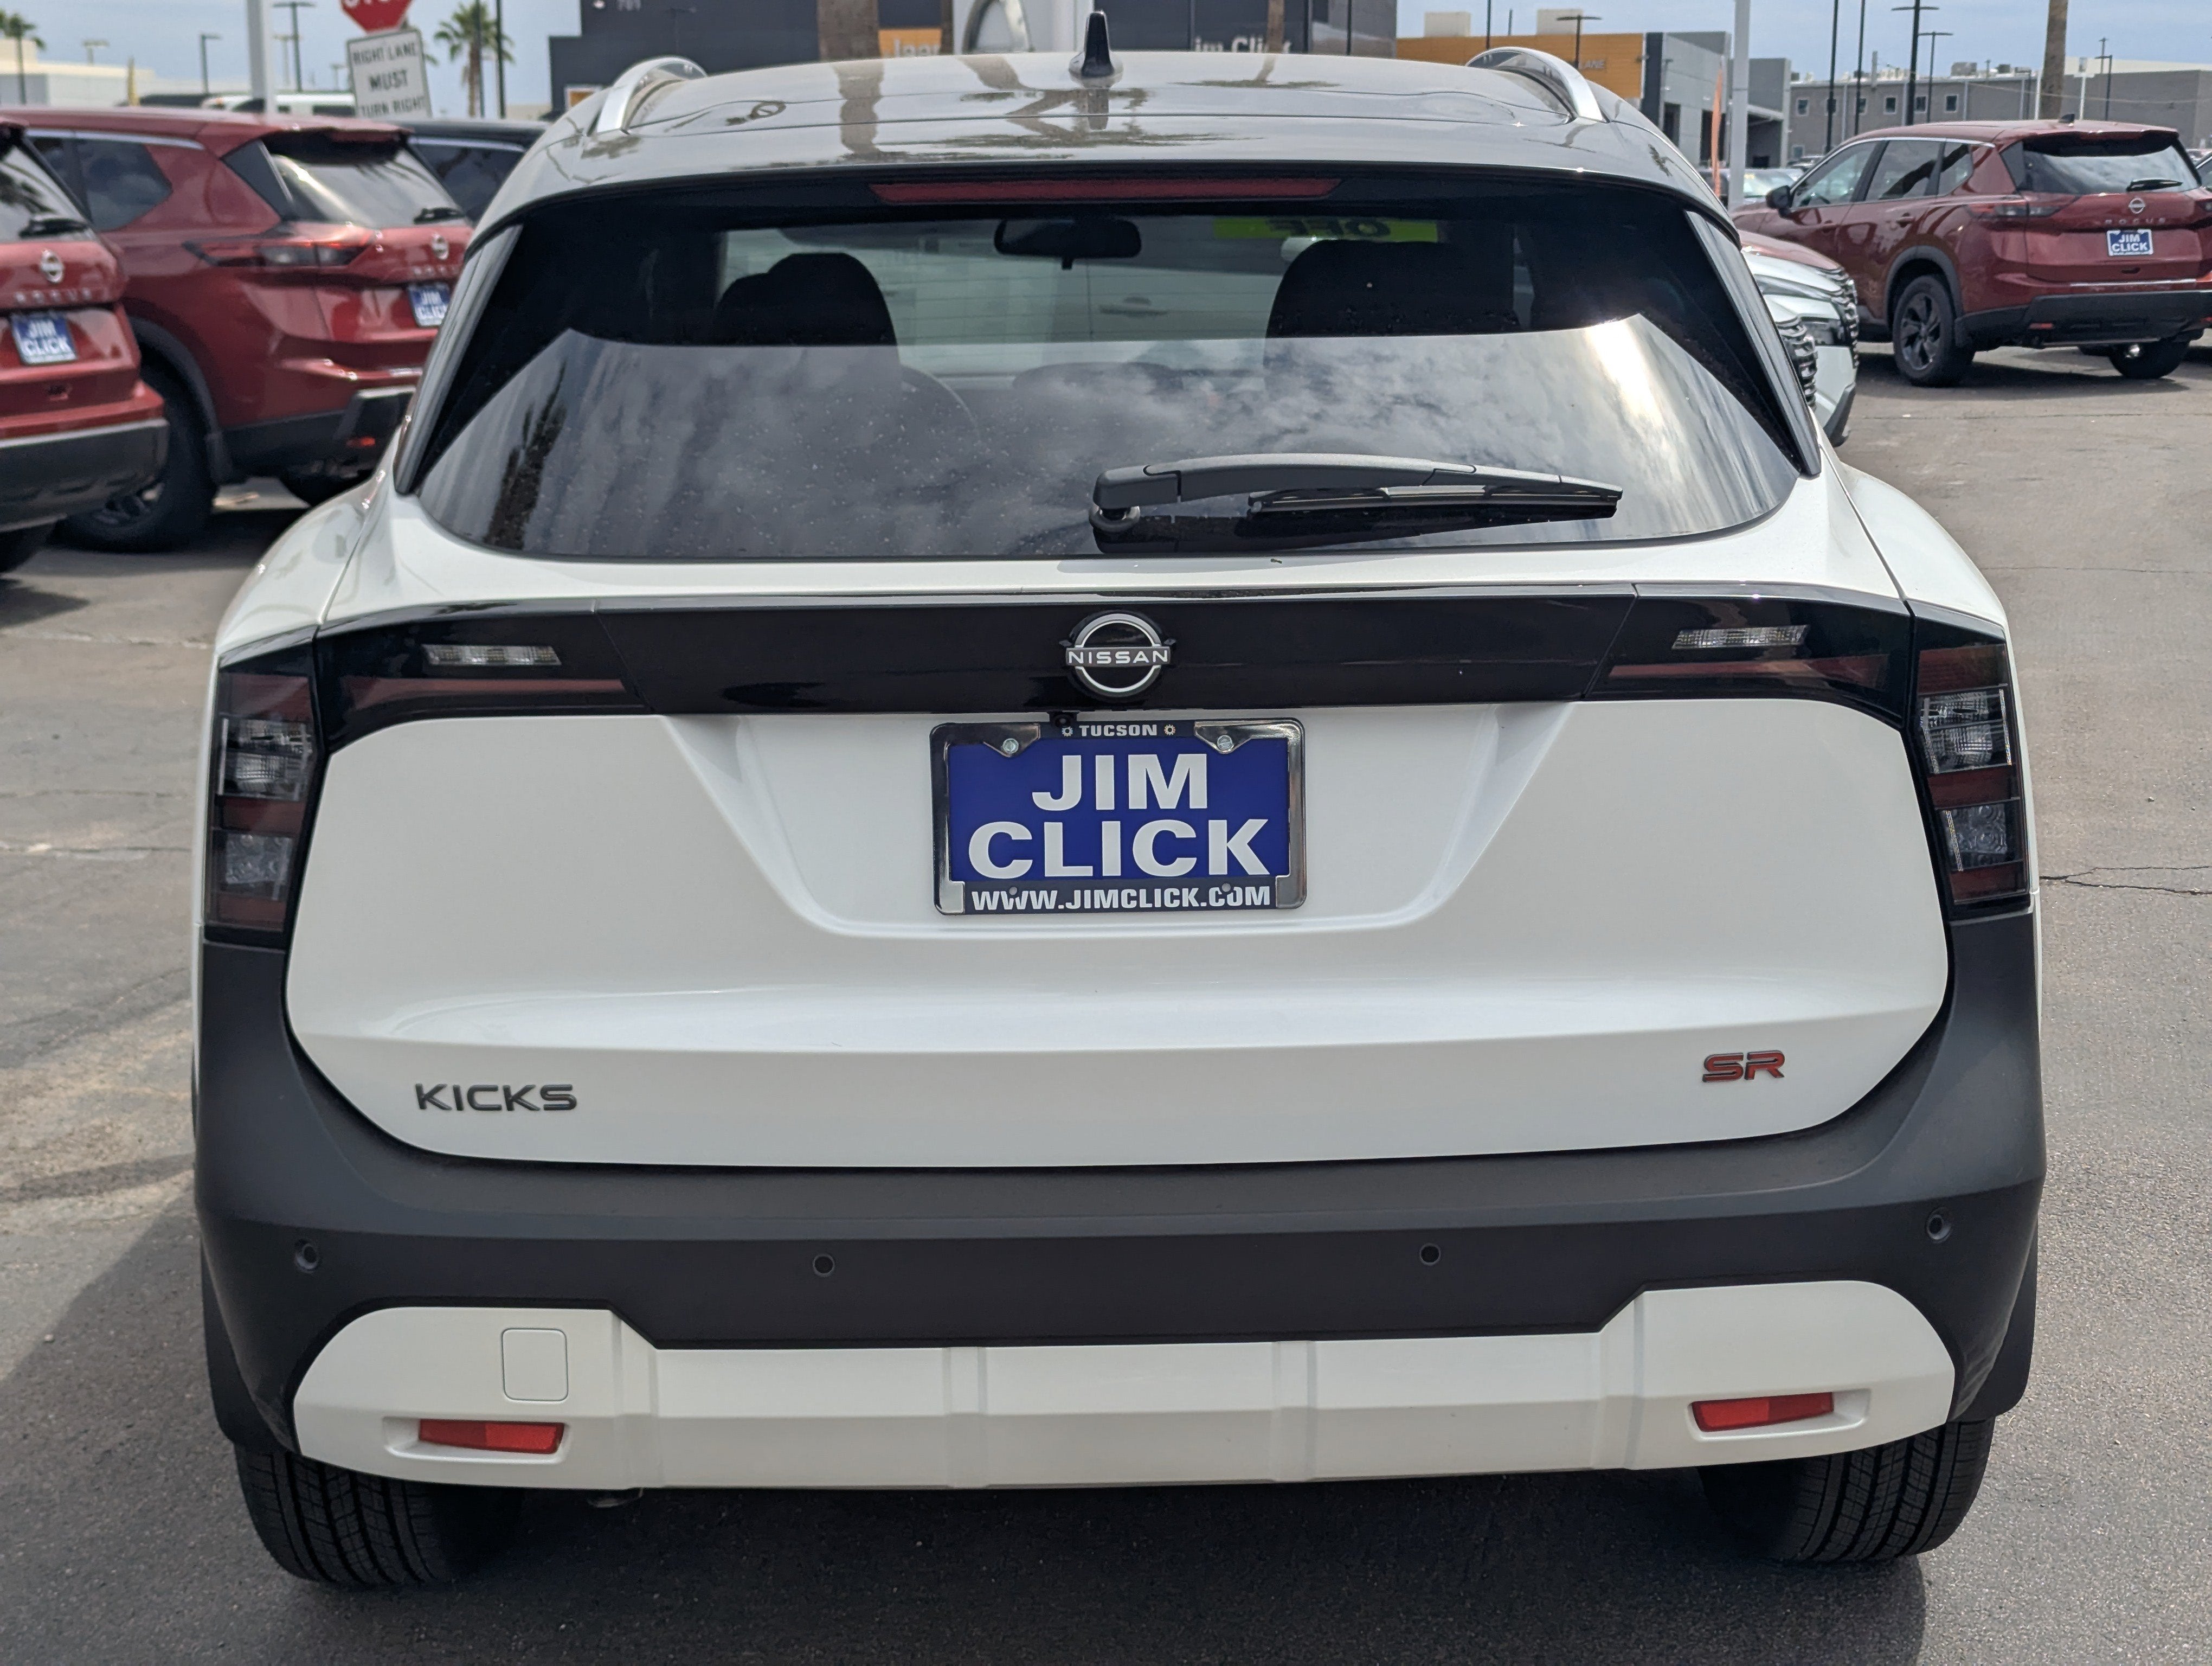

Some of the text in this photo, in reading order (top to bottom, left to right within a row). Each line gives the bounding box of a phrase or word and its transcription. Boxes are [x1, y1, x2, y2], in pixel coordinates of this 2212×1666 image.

[369, 69, 408, 91] MUST
[2112, 242, 2148, 252] CLICK
[2119, 234, 2140, 243] JIM
[27, 320, 56, 338] JIM
[21, 337, 73, 356] CLICK
[1068, 650, 1168, 664] NISSAN
[1079, 724, 1158, 736] TUCSON
[1032, 753, 1208, 811] JIM
[968, 819, 1270, 879] CLICK
[972, 885, 1271, 911] WWW.JIMCLICK.COM
[1702, 1049, 1785, 1083] SR
[415, 1083, 577, 1112] KICKS
